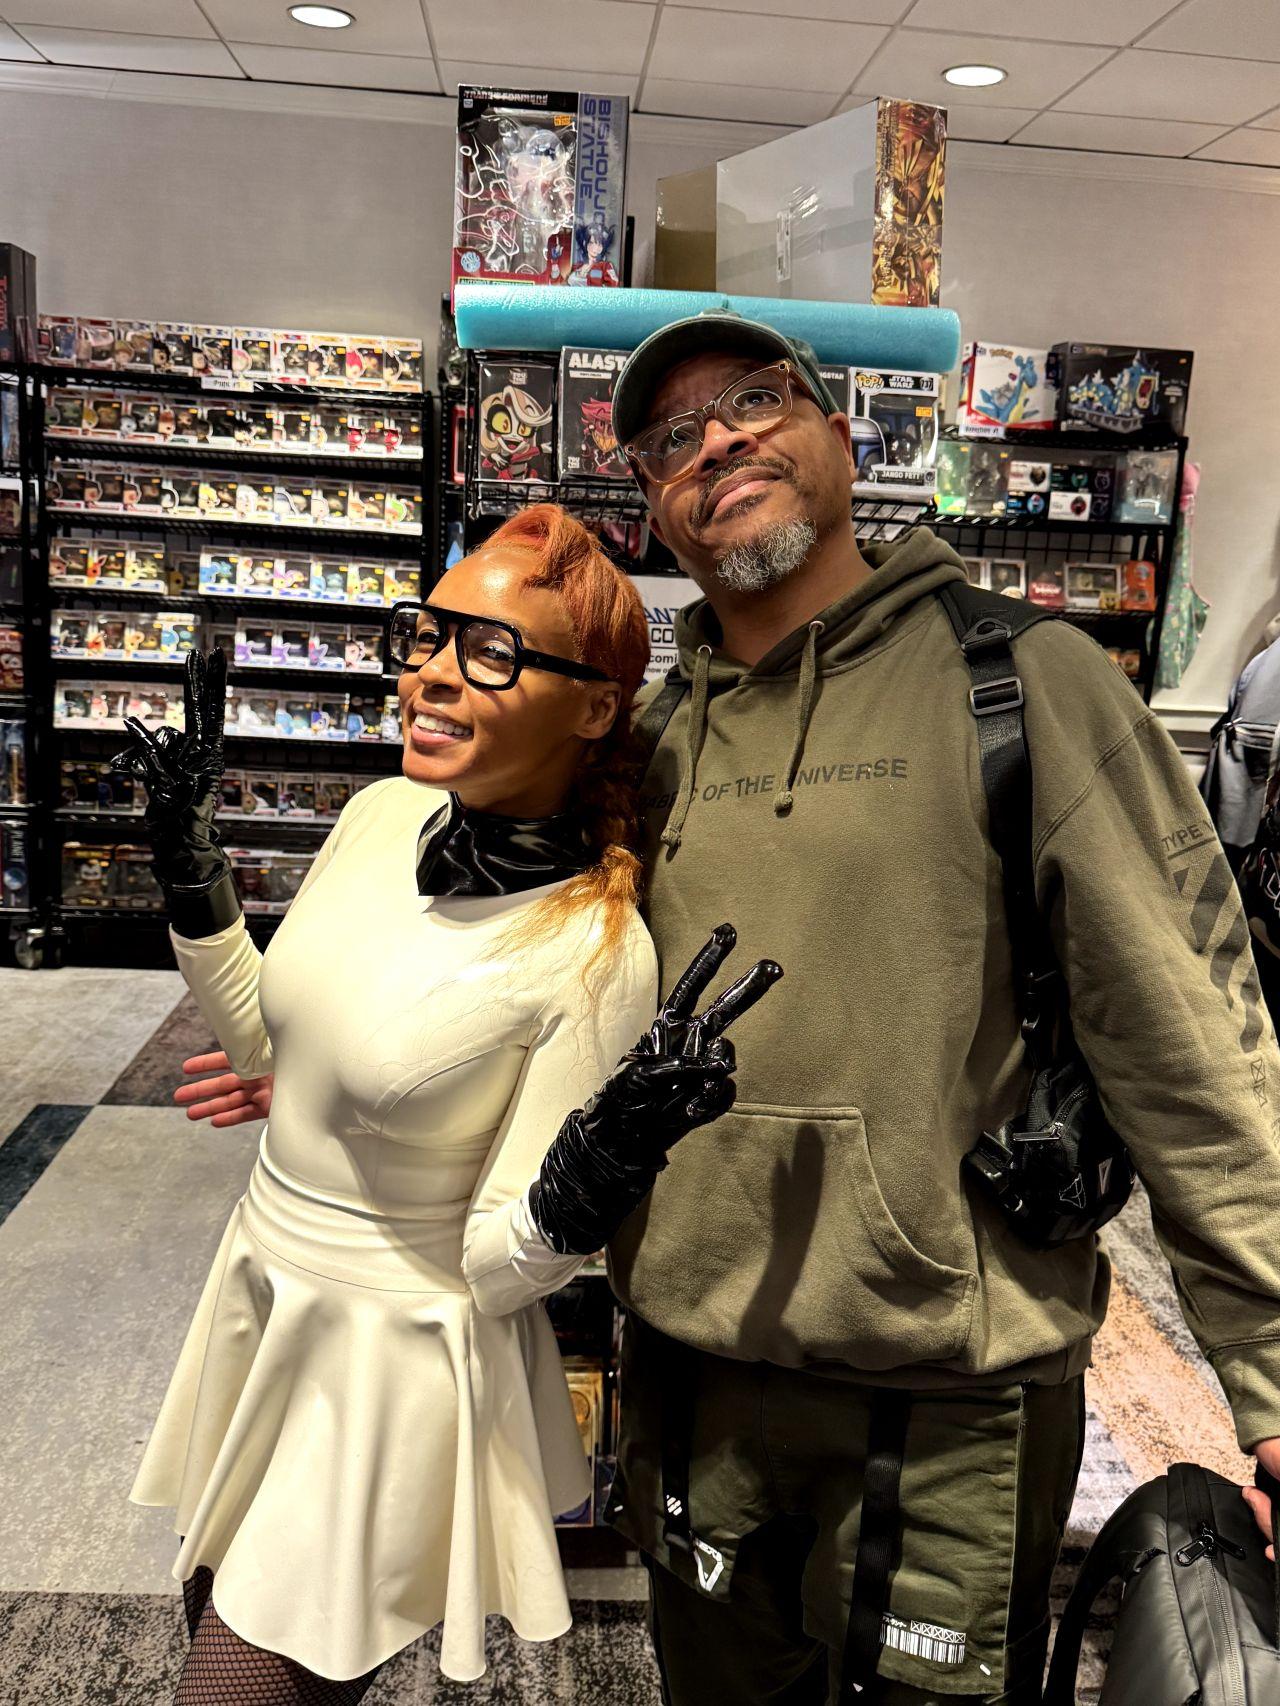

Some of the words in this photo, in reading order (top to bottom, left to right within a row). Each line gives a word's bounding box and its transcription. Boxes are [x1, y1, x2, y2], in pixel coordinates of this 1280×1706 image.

[580, 99, 597, 199] STATUE
[881, 470, 903, 479] JANGO
[904, 471, 920, 480] FETT
[702, 782, 731, 801] OF
[735, 774, 775, 798] THE
[797, 758, 909, 787] NIVERSE
[1160, 823, 1204, 851] TYPE
